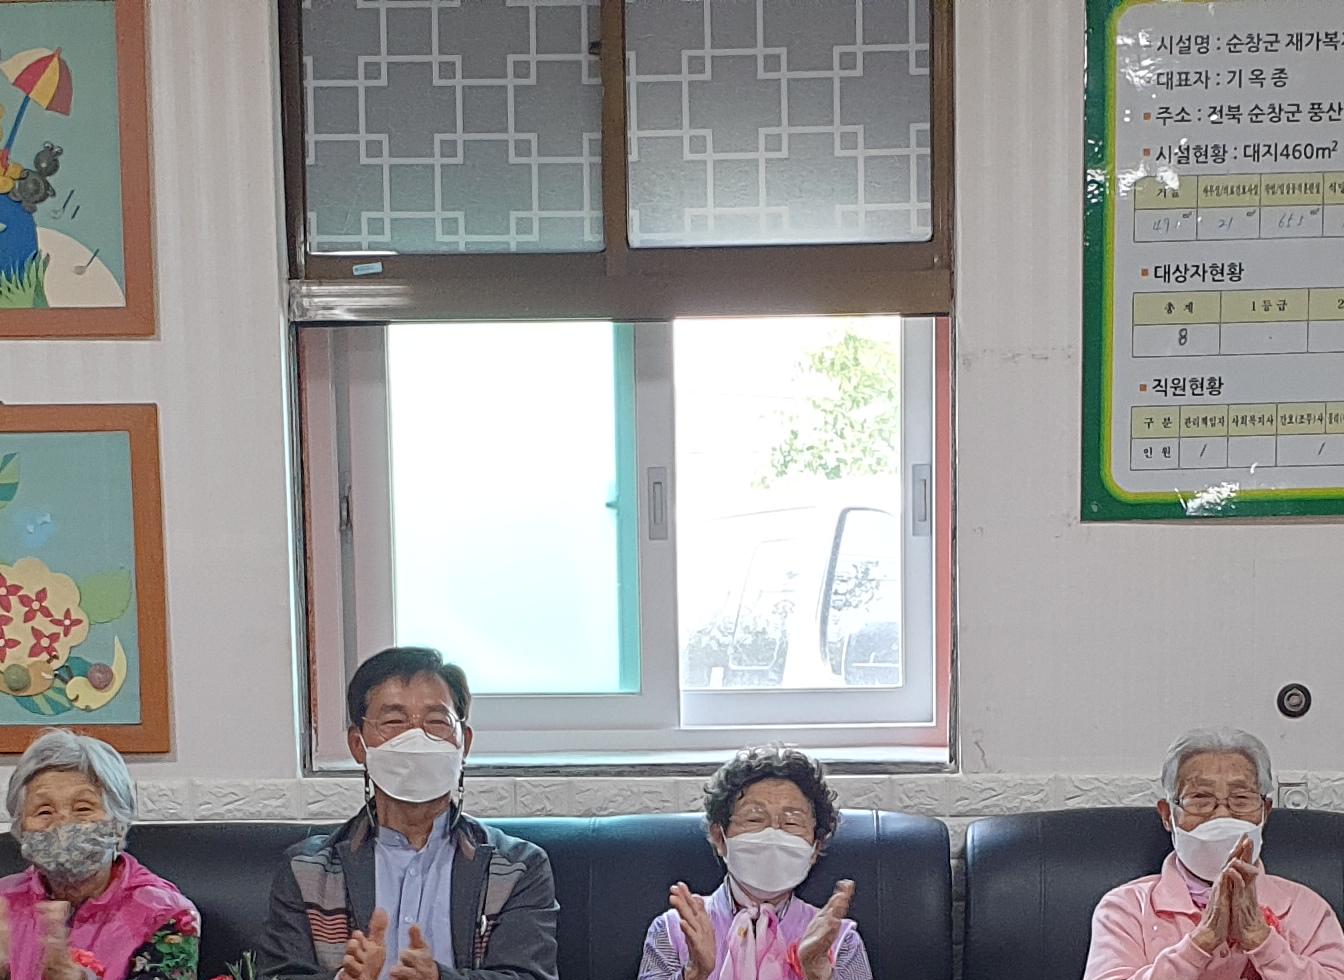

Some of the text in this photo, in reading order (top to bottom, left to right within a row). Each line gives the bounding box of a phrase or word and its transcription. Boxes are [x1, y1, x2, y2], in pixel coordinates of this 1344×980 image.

[1156, 34, 1210, 55] 시설명
[1226, 32, 1281, 53] 순창군
[1156, 69, 1210, 90] 대표자
[1156, 105, 1192, 126] 주소
[1207, 104, 1243, 125] 전북
[1248, 103, 1302, 124] 순창군
[1156, 143, 1228, 164] 시설현황
[1154, 262, 1245, 283] 대상자현황
[1152, 376, 1225, 397] 직원현황
